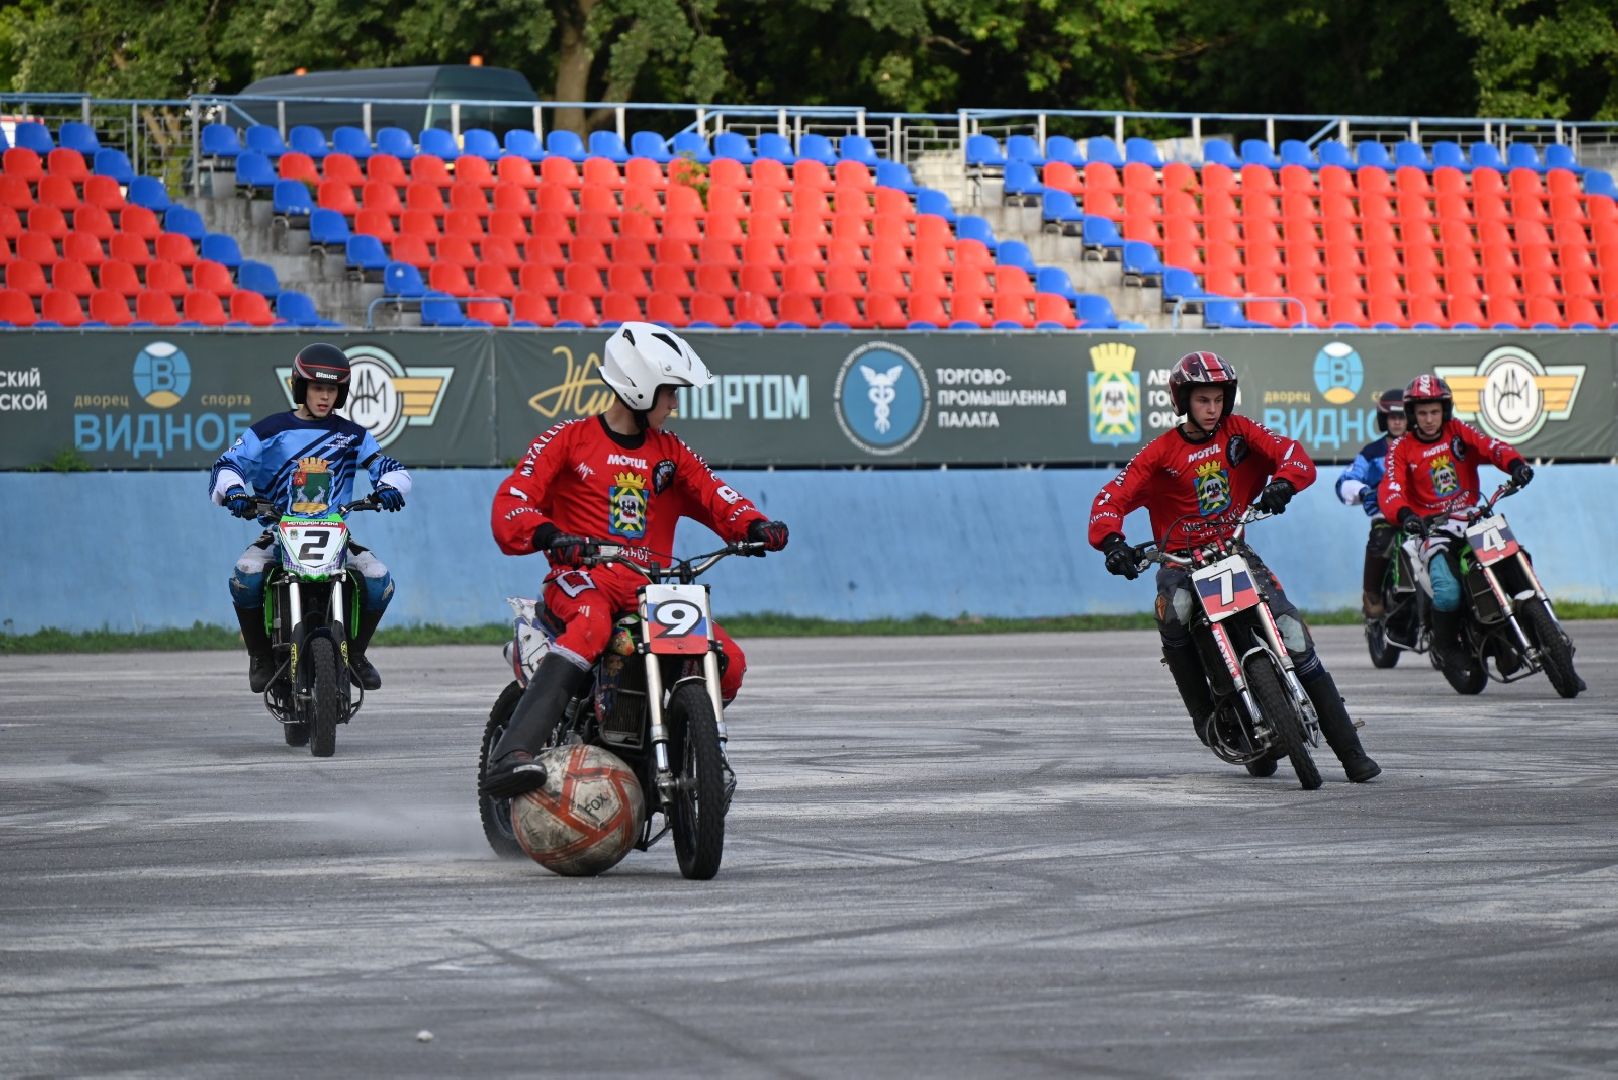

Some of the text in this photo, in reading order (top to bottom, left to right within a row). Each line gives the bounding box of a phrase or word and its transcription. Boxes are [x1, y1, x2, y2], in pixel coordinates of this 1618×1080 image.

[936, 368, 1012, 385] ТОРГОВО-
[0, 390, 47, 410] СКОЙ
[74, 394, 251, 408] дворец спорта
[678, 375, 809, 419] ПОРТОМ
[938, 389, 1066, 406] ПРОМЫШЛЕННАЯ
[1264, 391, 1311, 404] дворец
[938, 411, 1000, 428] ПАЛАТА
[1263, 407, 1388, 451] ВИДНО
[74, 412, 252, 459] ВИДНОЕ
[1188, 443, 1221, 463] MOTUL
[1423, 442, 1449, 458] MOTUL
[606, 454, 649, 469] MOTUL
[298, 530, 330, 560] 2
[1482, 526, 1506, 552] 4
[1208, 567, 1235, 607] 7
[653, 599, 702, 639] 9
[584, 793, 607, 817] FOX
